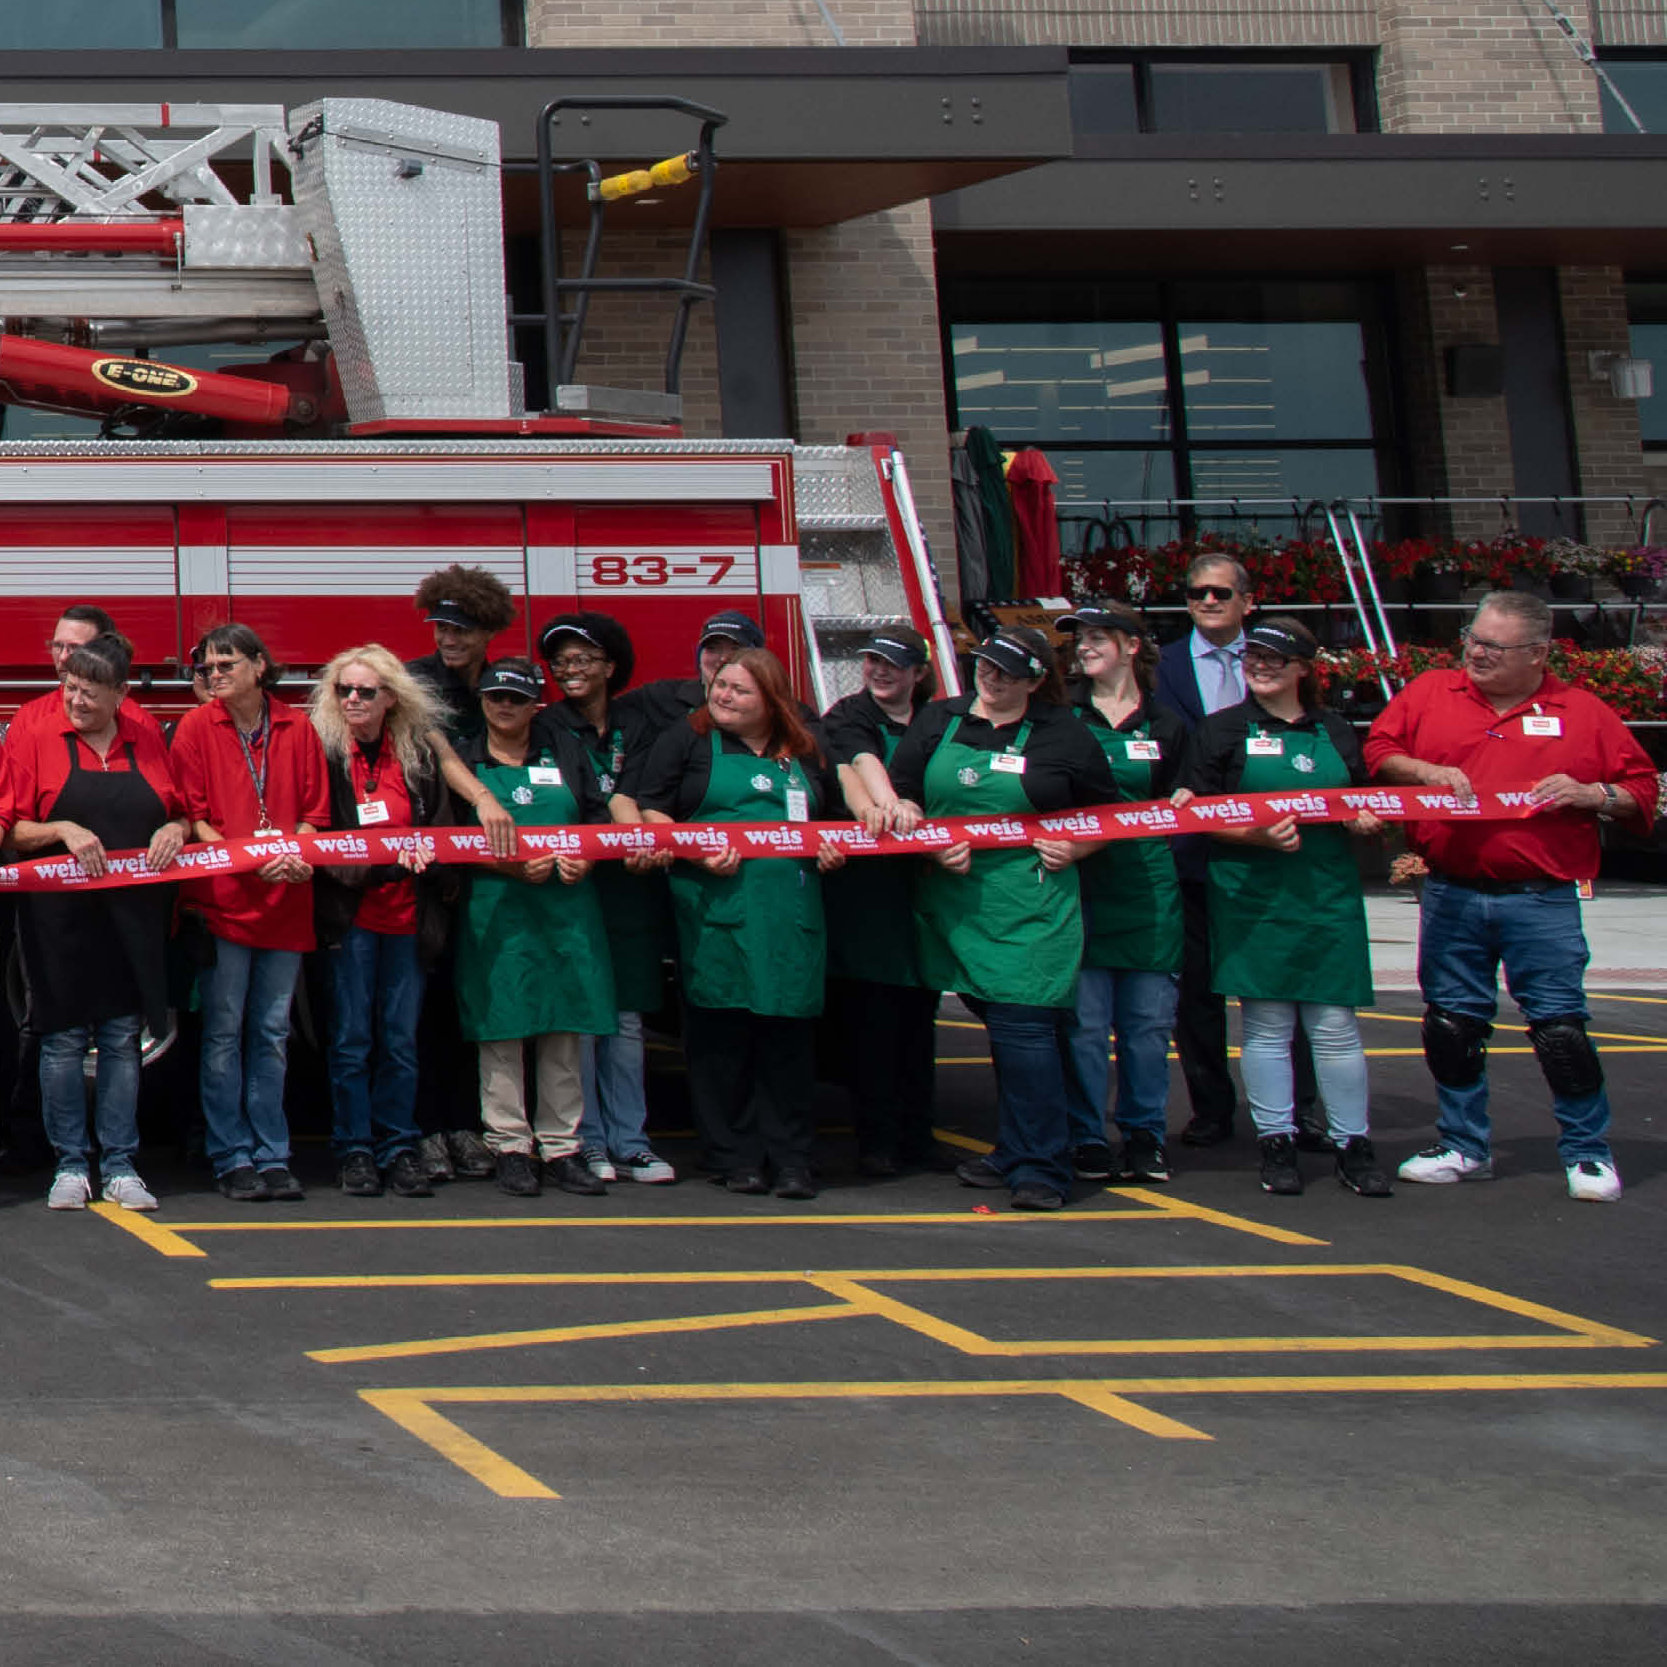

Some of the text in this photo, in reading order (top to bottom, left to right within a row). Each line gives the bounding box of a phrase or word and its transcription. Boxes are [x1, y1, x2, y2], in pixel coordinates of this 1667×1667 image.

[592, 555, 735, 586] 83-7
[1190, 799, 1252, 819] weis
[1266, 792, 1327, 813] weis
[1341, 791, 1402, 810] weis
[1039, 812, 1100, 832] weis
[1115, 806, 1176, 827] weis
[671, 827, 728, 845] weis
[744, 826, 803, 845] weis
[964, 818, 1024, 836] weis
[313, 834, 368, 852] weis
[450, 834, 485, 849] we
[522, 830, 581, 848] weis
[597, 828, 656, 847] weis
[176, 846, 230, 867] weis
[244, 839, 301, 857] weis
[106, 853, 148, 873] wei
